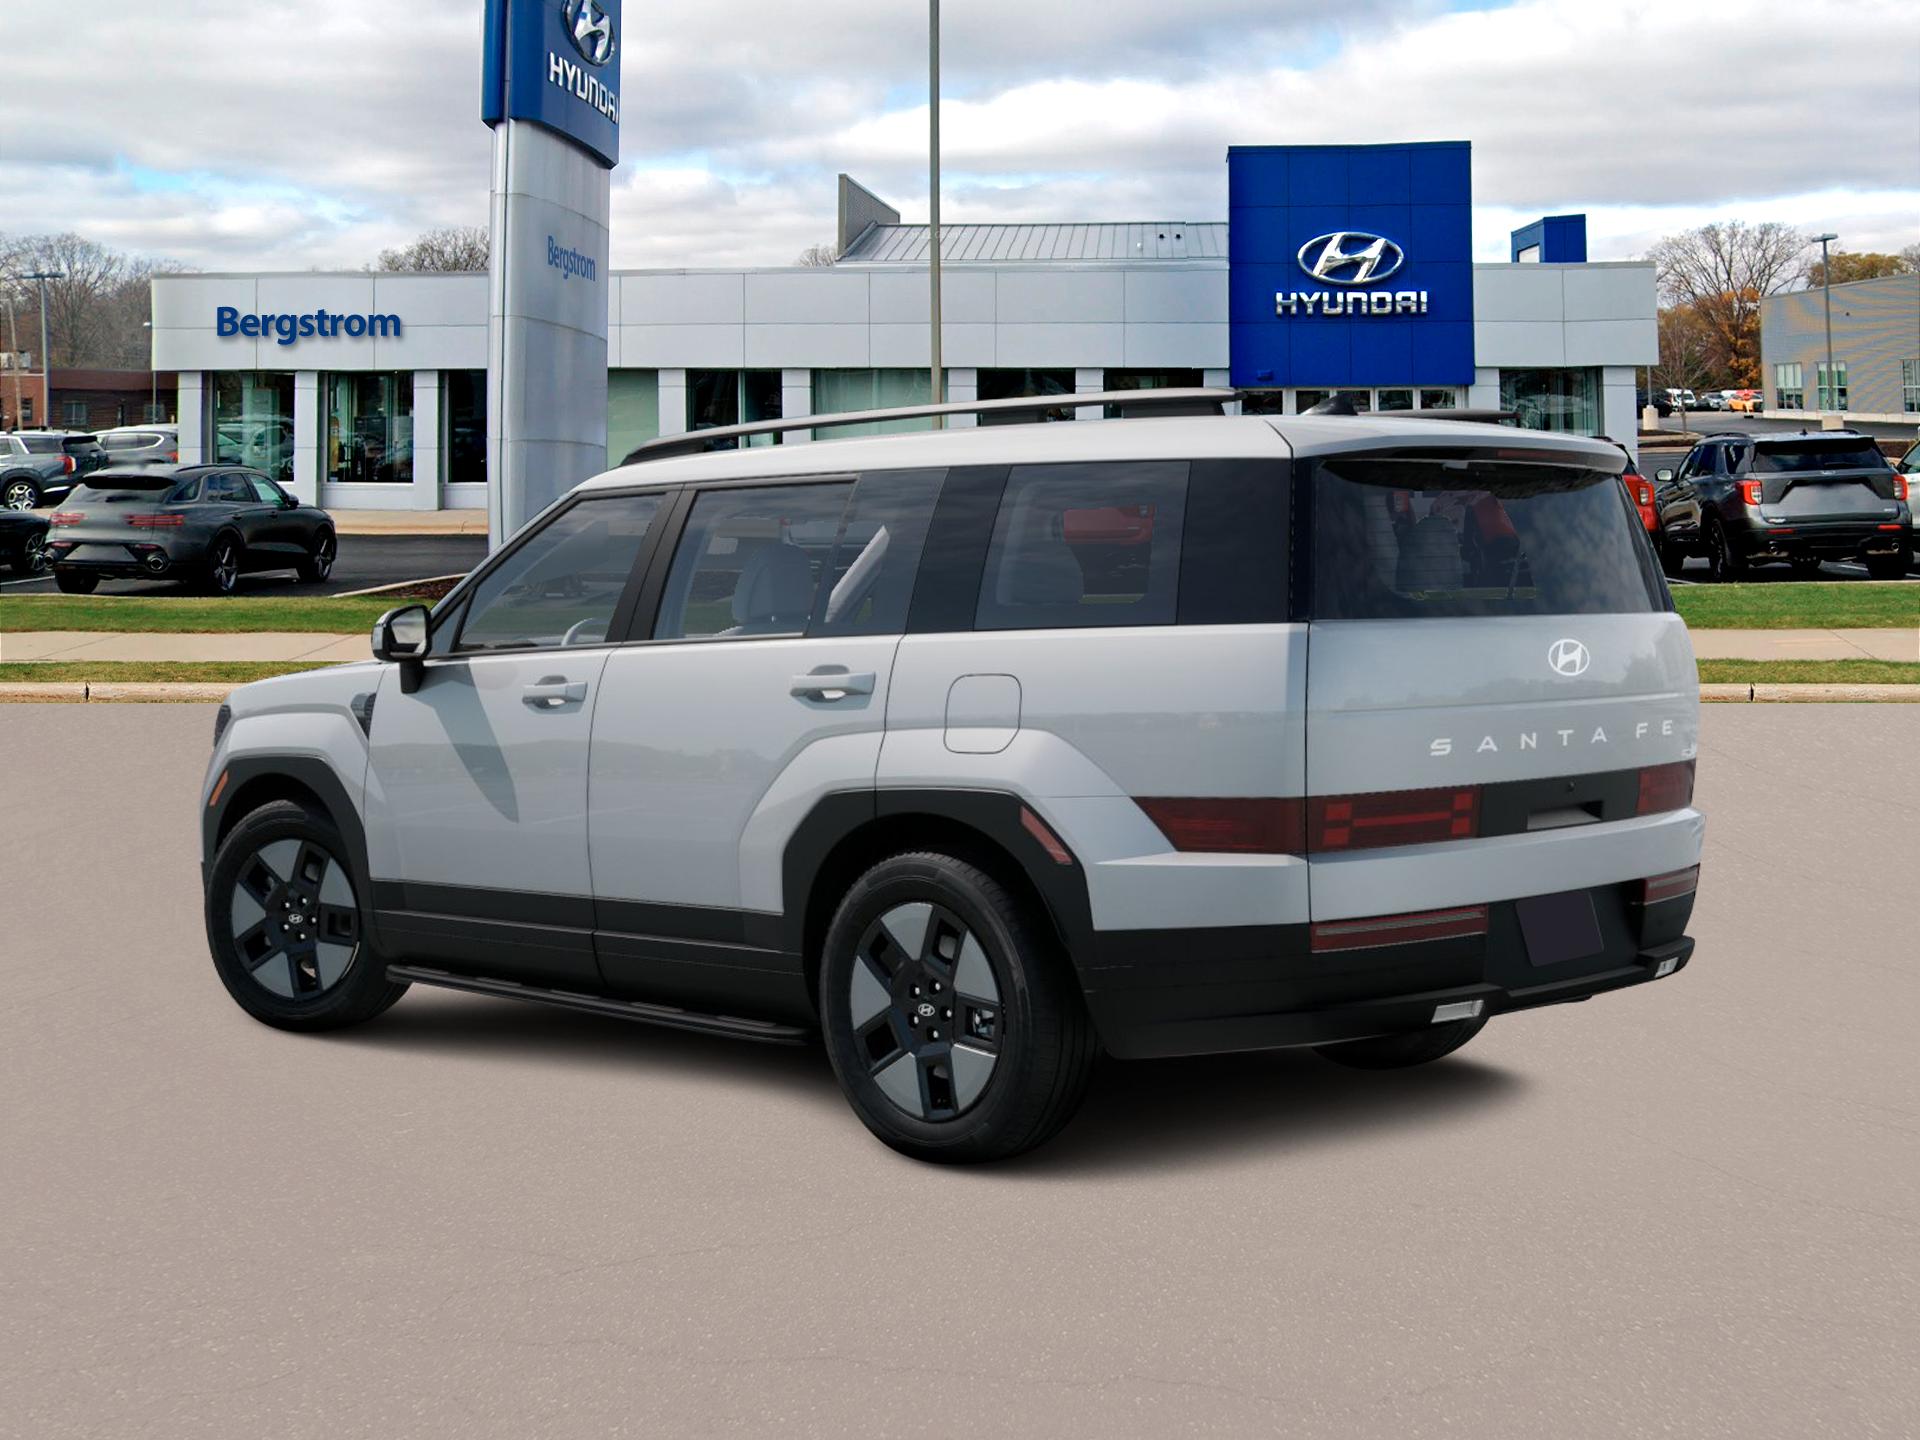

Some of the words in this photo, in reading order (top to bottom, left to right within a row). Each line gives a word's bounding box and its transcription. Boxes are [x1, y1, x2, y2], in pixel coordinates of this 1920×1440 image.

[548, 52, 619, 124] HYUNDAI
[547, 235, 596, 281] Bergstrom
[1275, 291, 1428, 315] HYUNDAI
[217, 306, 401, 345] Bergstrom
[1430, 727, 1608, 756] SANTA
[1636, 720, 1673, 739] FE
